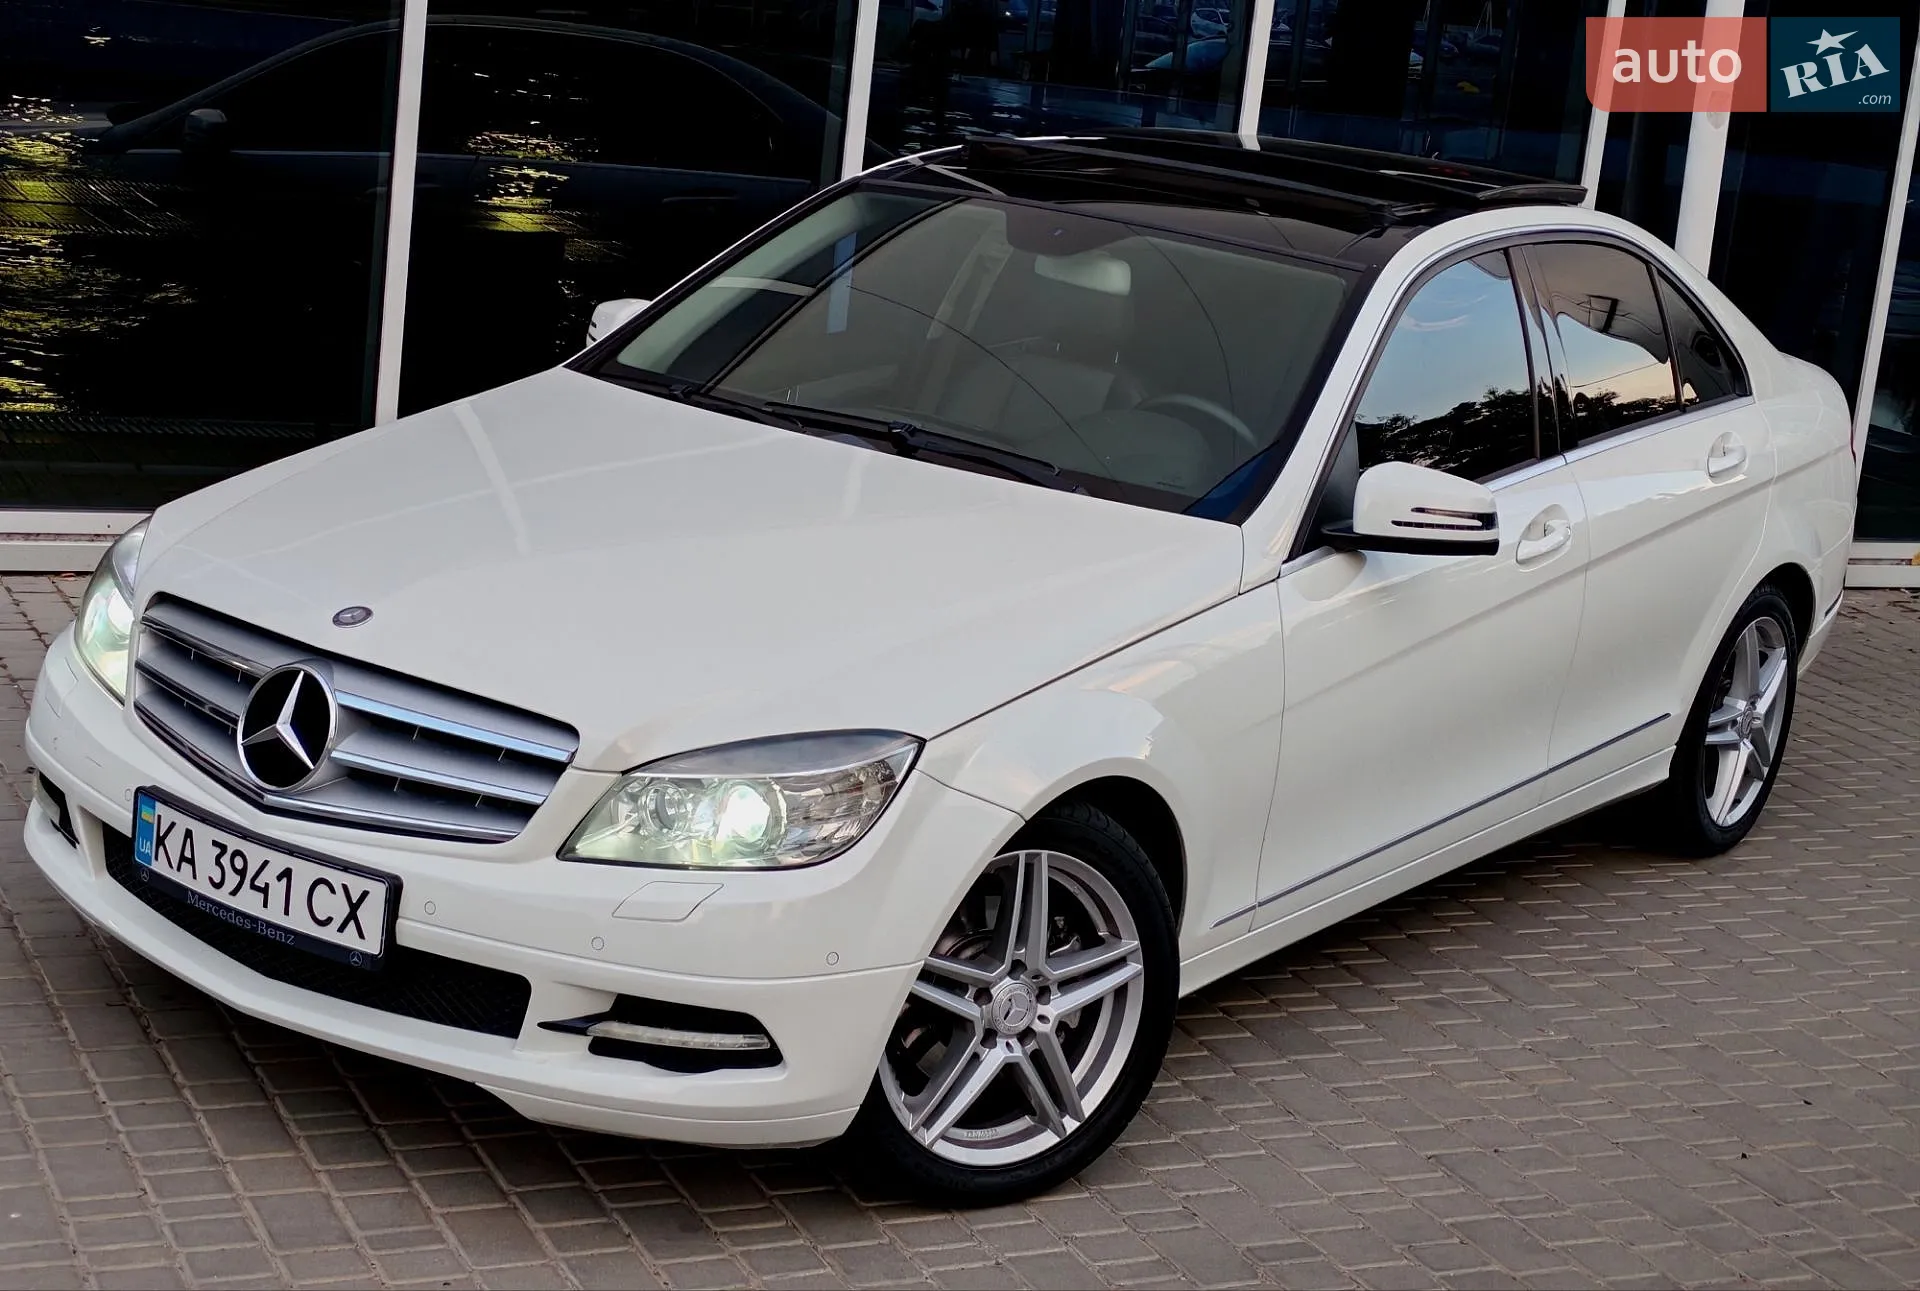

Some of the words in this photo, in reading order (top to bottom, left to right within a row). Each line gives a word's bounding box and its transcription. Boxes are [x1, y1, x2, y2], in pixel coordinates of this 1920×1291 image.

[139, 839, 152, 855] UA
[155, 814, 197, 880] KA
[208, 840, 293, 916] 3941
[307, 877, 370, 940] CX
[187, 891, 295, 946] Mercedes-Benz
